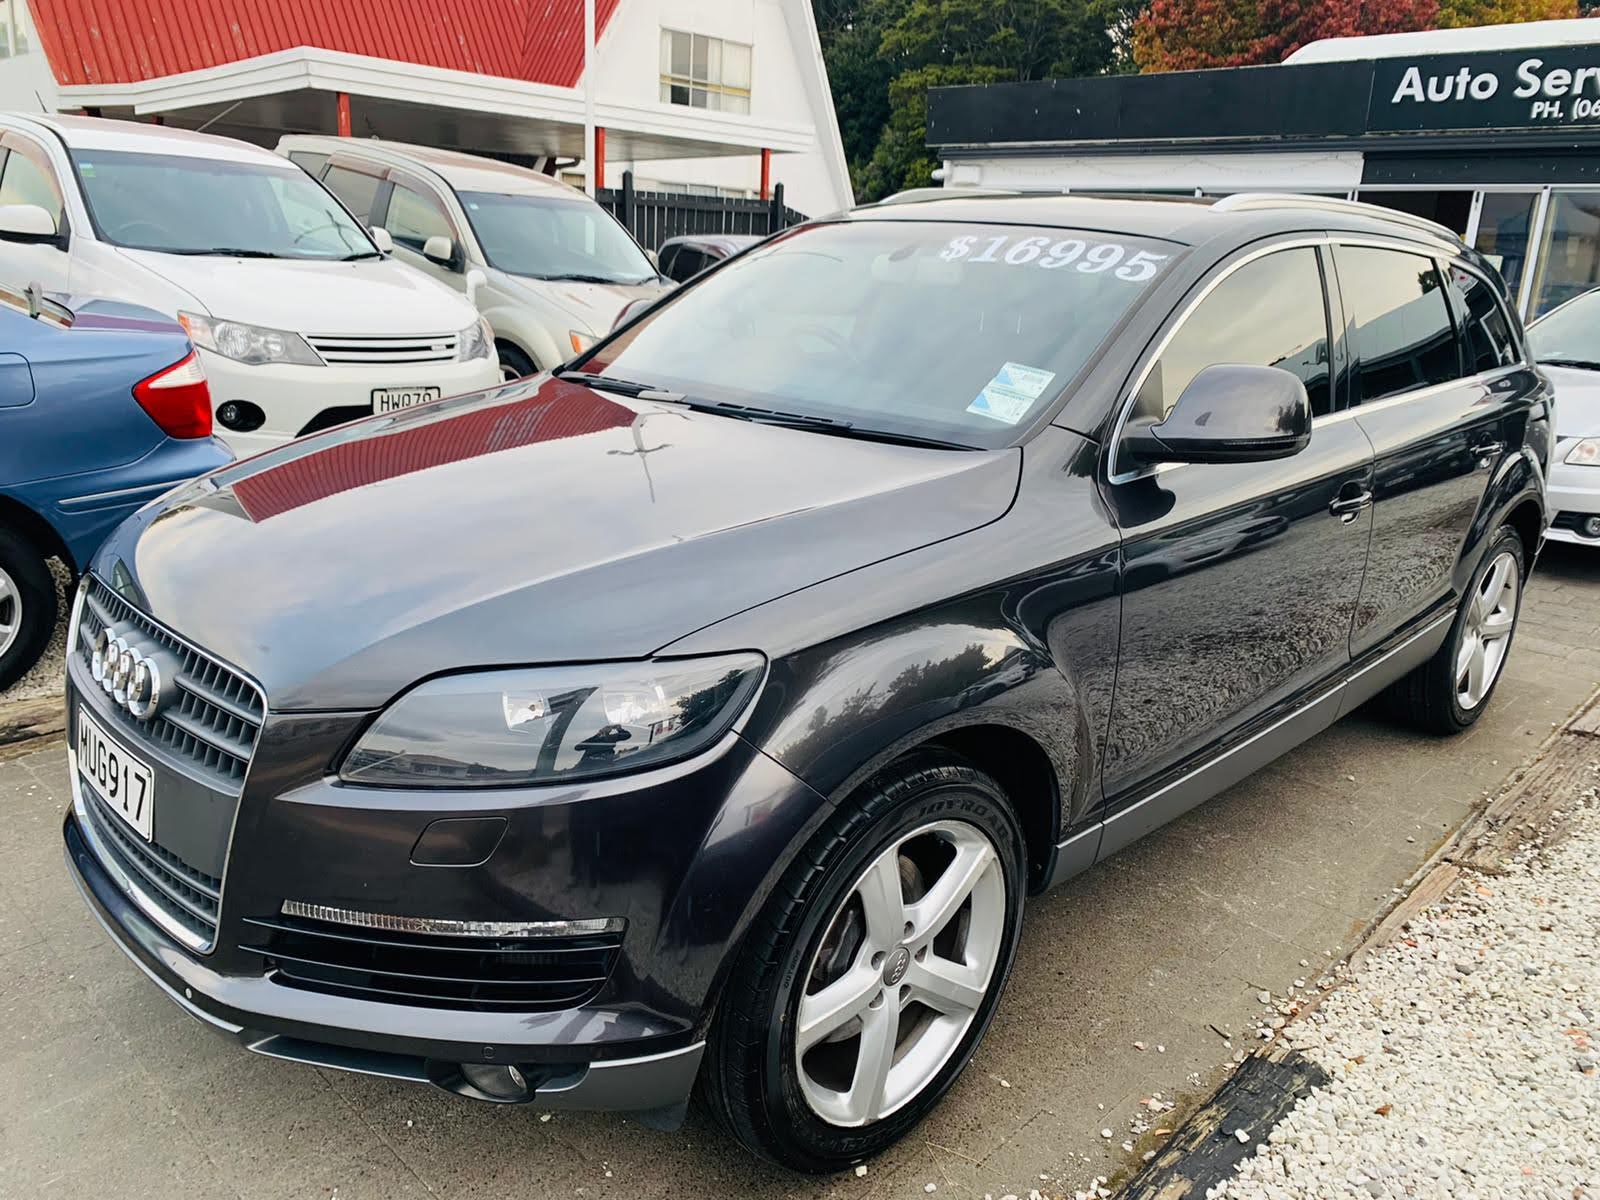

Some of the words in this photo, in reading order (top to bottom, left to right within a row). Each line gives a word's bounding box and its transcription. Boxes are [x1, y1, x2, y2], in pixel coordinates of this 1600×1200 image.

[1391, 66, 1499, 104] Auto
[1513, 58, 1600, 98] Ser
[1530, 100, 1564, 119] PH.
[939, 234, 1168, 282] $16995
